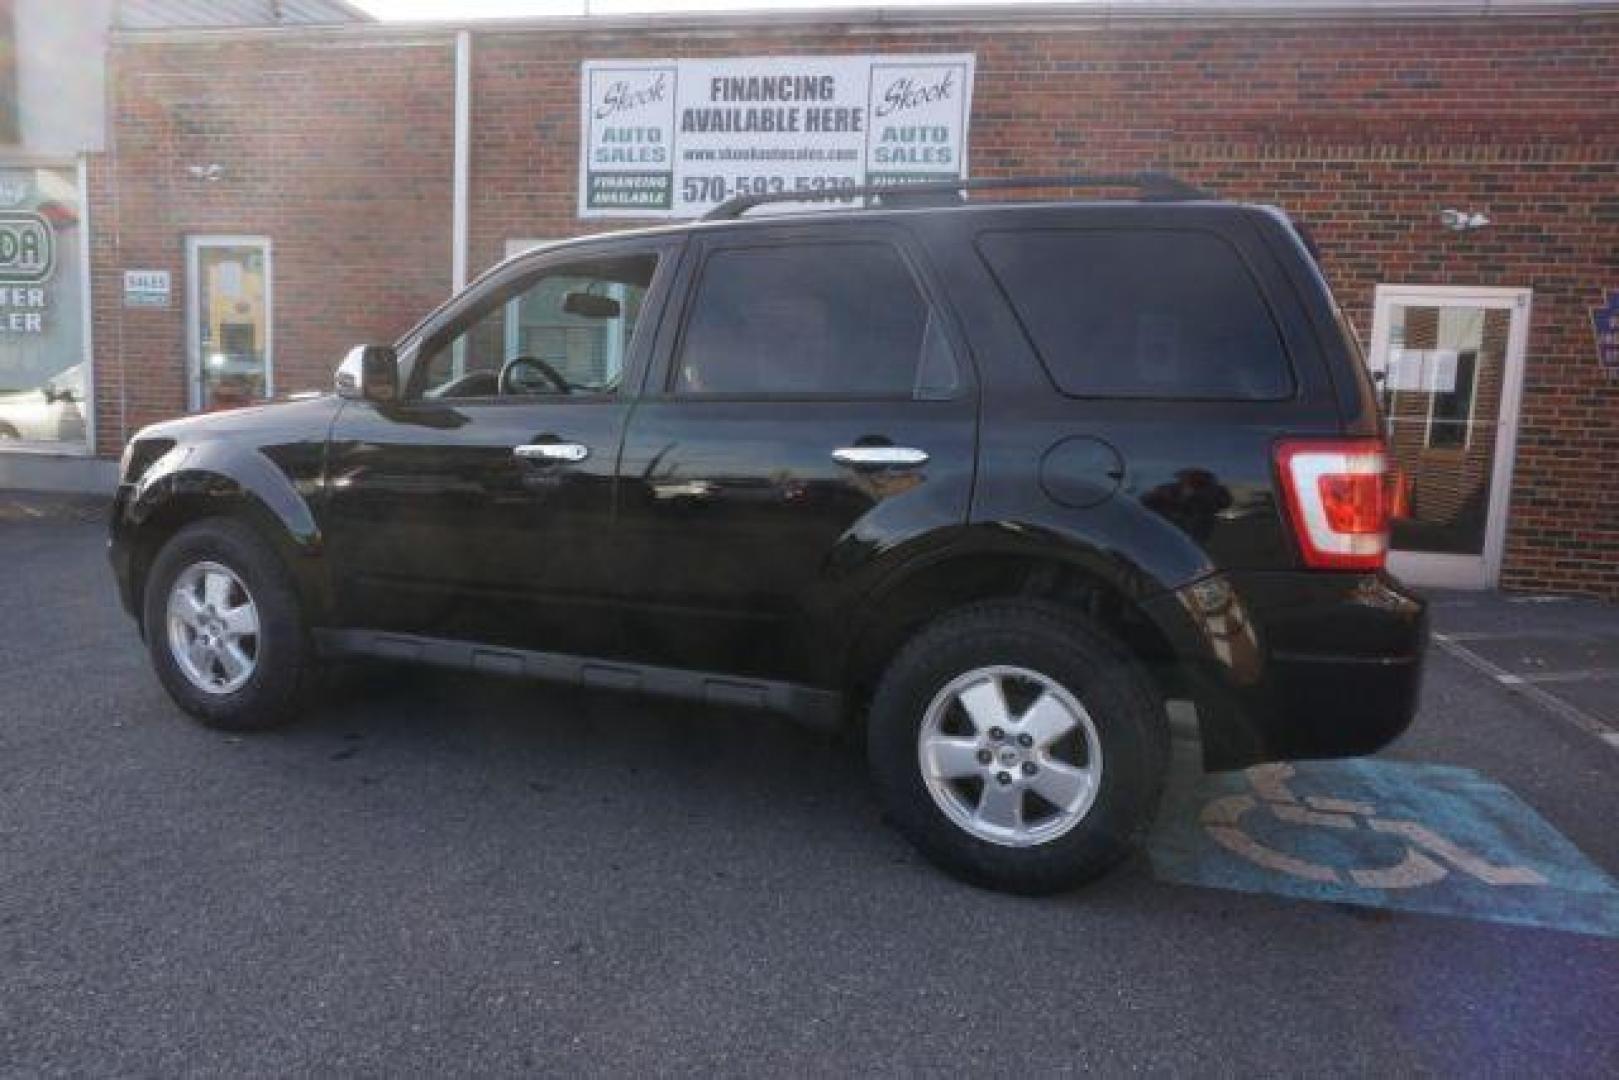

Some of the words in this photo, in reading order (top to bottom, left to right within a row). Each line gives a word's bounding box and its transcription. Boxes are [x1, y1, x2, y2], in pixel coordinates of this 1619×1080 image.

[710, 76, 835, 101] FINANCING
[875, 71, 951, 117] Skook
[682, 108, 801, 132] AVAILABLE
[804, 107, 863, 132] HERE
[601, 127, 662, 143] AUTO
[881, 126, 949, 142] AUTO
[594, 146, 666, 163] SALES
[874, 147, 952, 162] SALES
